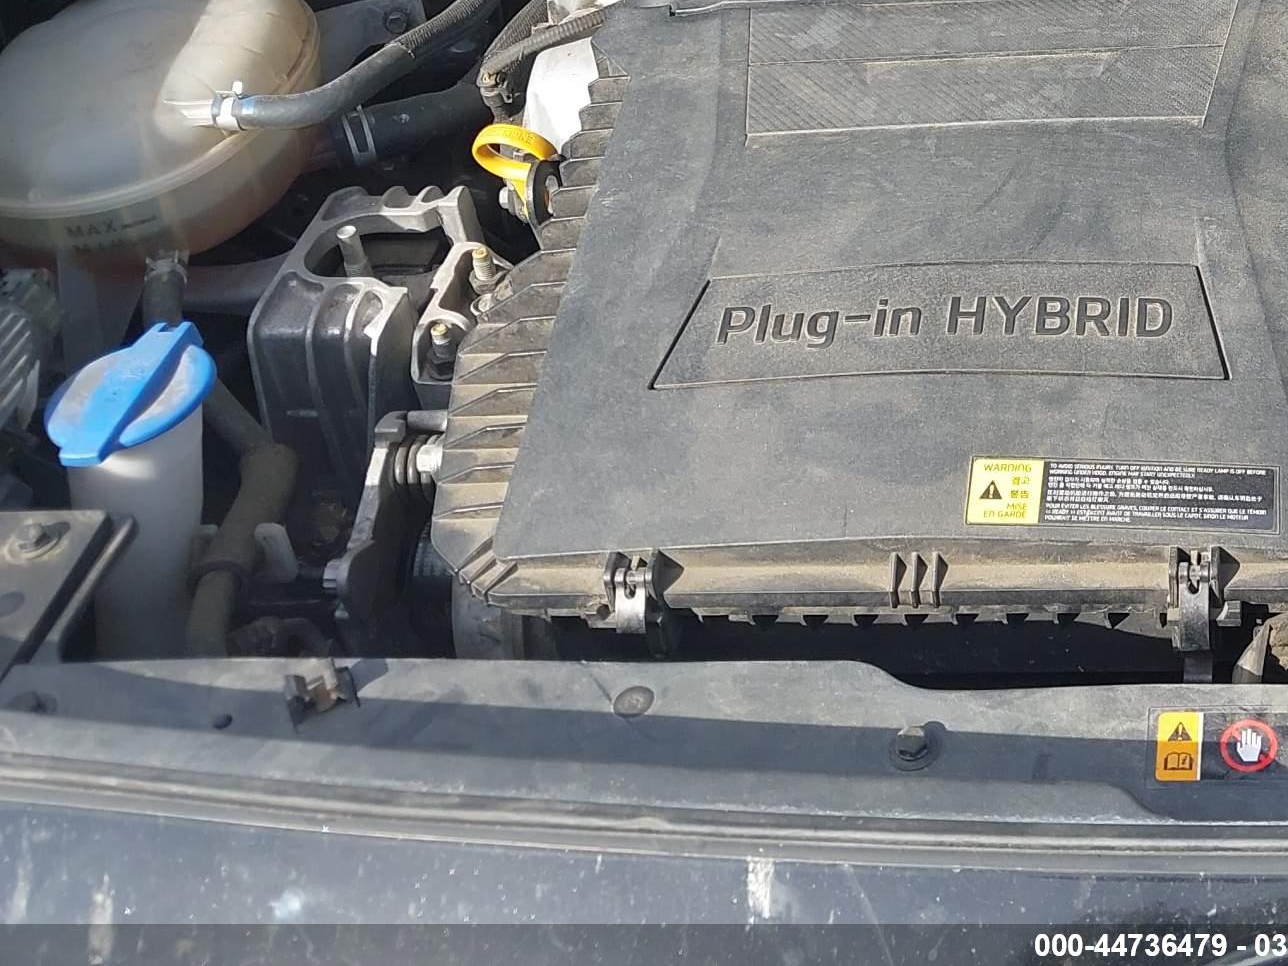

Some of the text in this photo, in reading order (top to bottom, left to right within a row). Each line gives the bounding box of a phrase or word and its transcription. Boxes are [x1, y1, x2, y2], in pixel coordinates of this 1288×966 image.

[64, 219, 118, 237] MAX
[716, 296, 1173, 349] Plug-in HYBRID
[983, 463, 1032, 473] WARNING
[1007, 502, 1028, 510] MISE
[983, 510, 1027, 519] EN GARDE
